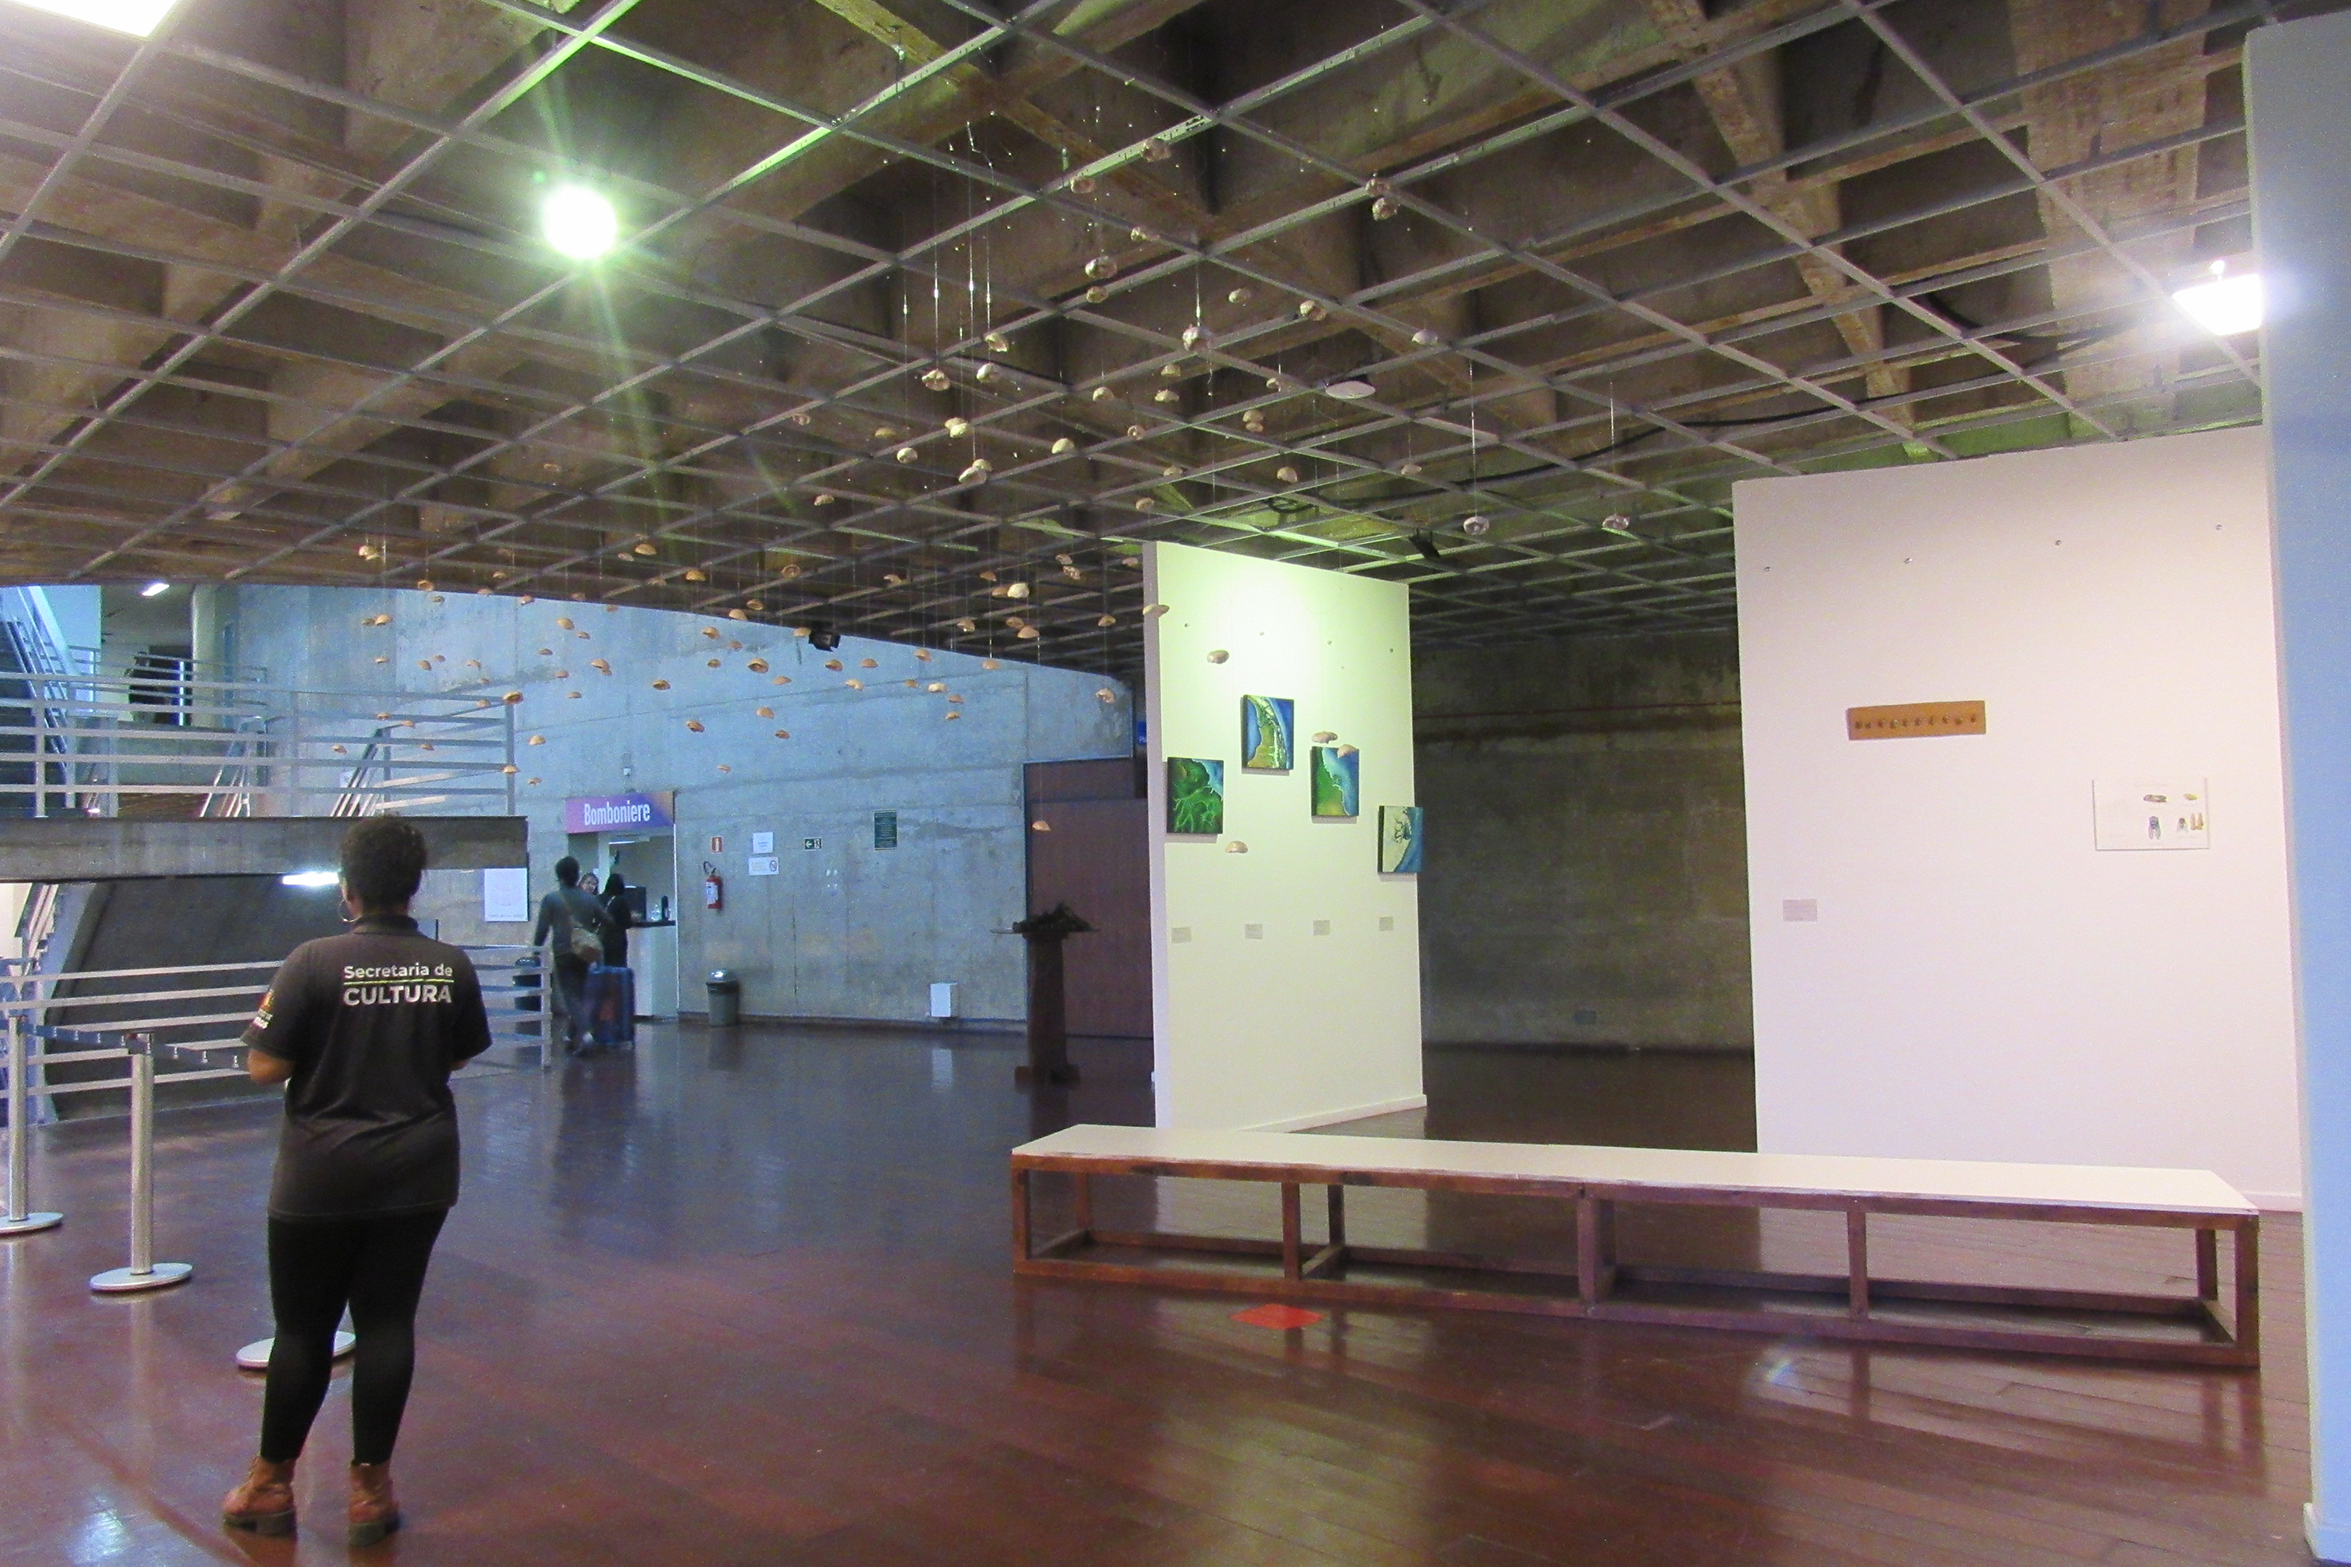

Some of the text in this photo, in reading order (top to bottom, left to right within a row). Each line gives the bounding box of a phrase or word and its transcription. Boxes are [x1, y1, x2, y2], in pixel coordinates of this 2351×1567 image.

[584, 800, 651, 826] Bomboniere
[343, 961, 454, 979] Secretaria de
[343, 985, 452, 1006] CULTURA
